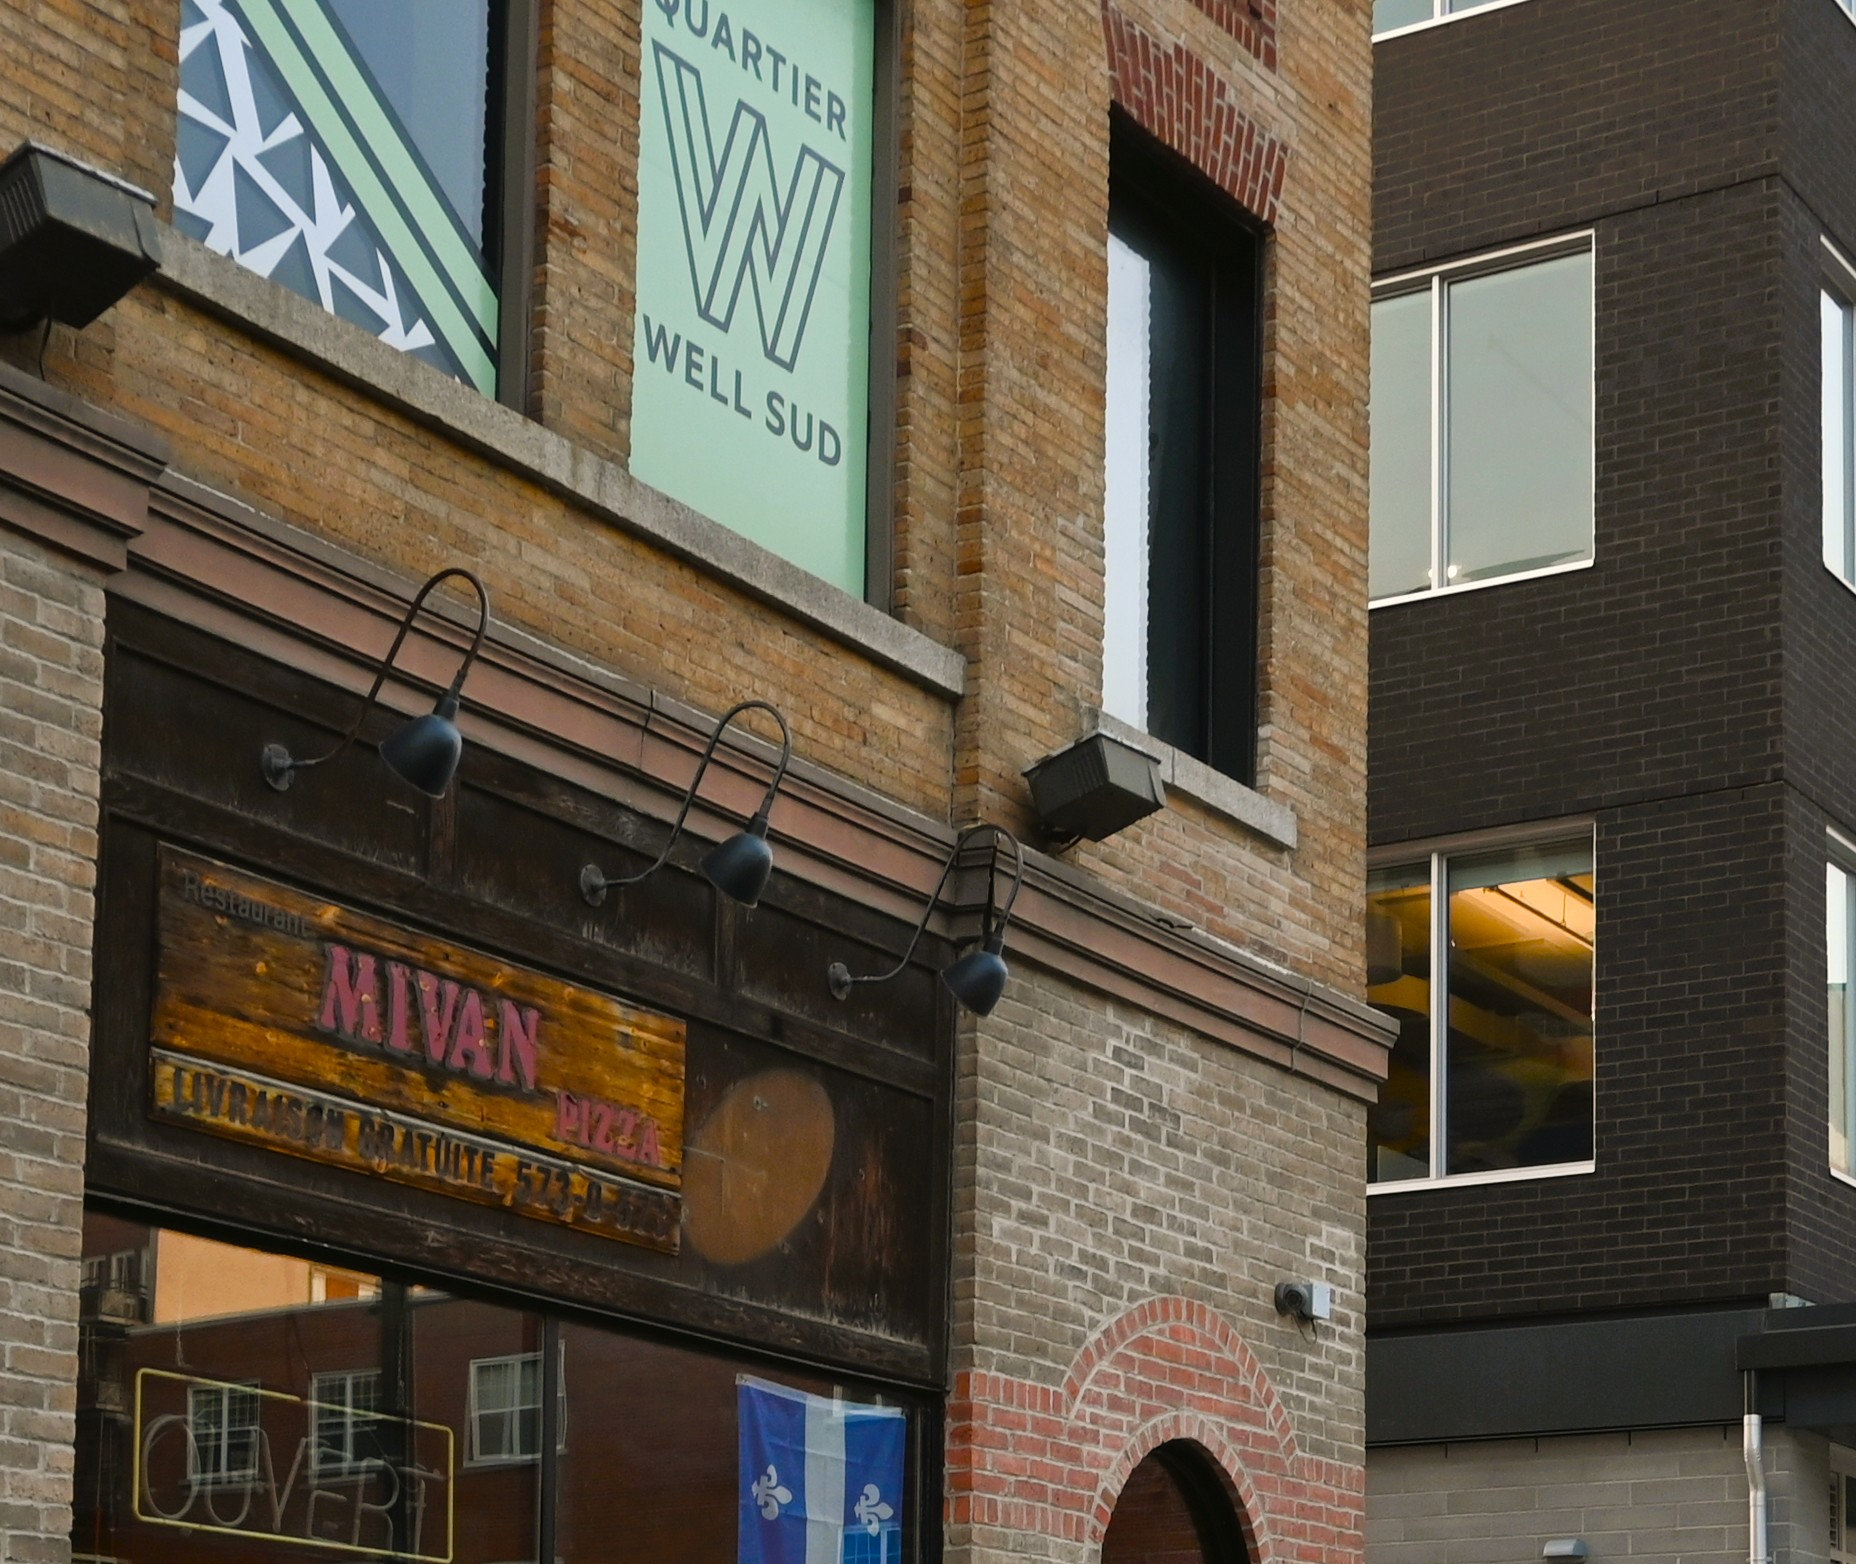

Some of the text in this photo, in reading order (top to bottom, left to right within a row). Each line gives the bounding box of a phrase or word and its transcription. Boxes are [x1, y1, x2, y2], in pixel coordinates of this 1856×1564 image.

[643, 313, 842, 468] WELL SUD
[183, 872, 310, 938] Restaurant
[317, 942, 542, 1091] MIVAN
[171, 1066, 345, 1152] LIVRAISON
[357, 1114, 496, 1192] GRATUITE
[555, 1088, 661, 1167] PIZZA
[143, 1413, 447, 1556] OUVERT
